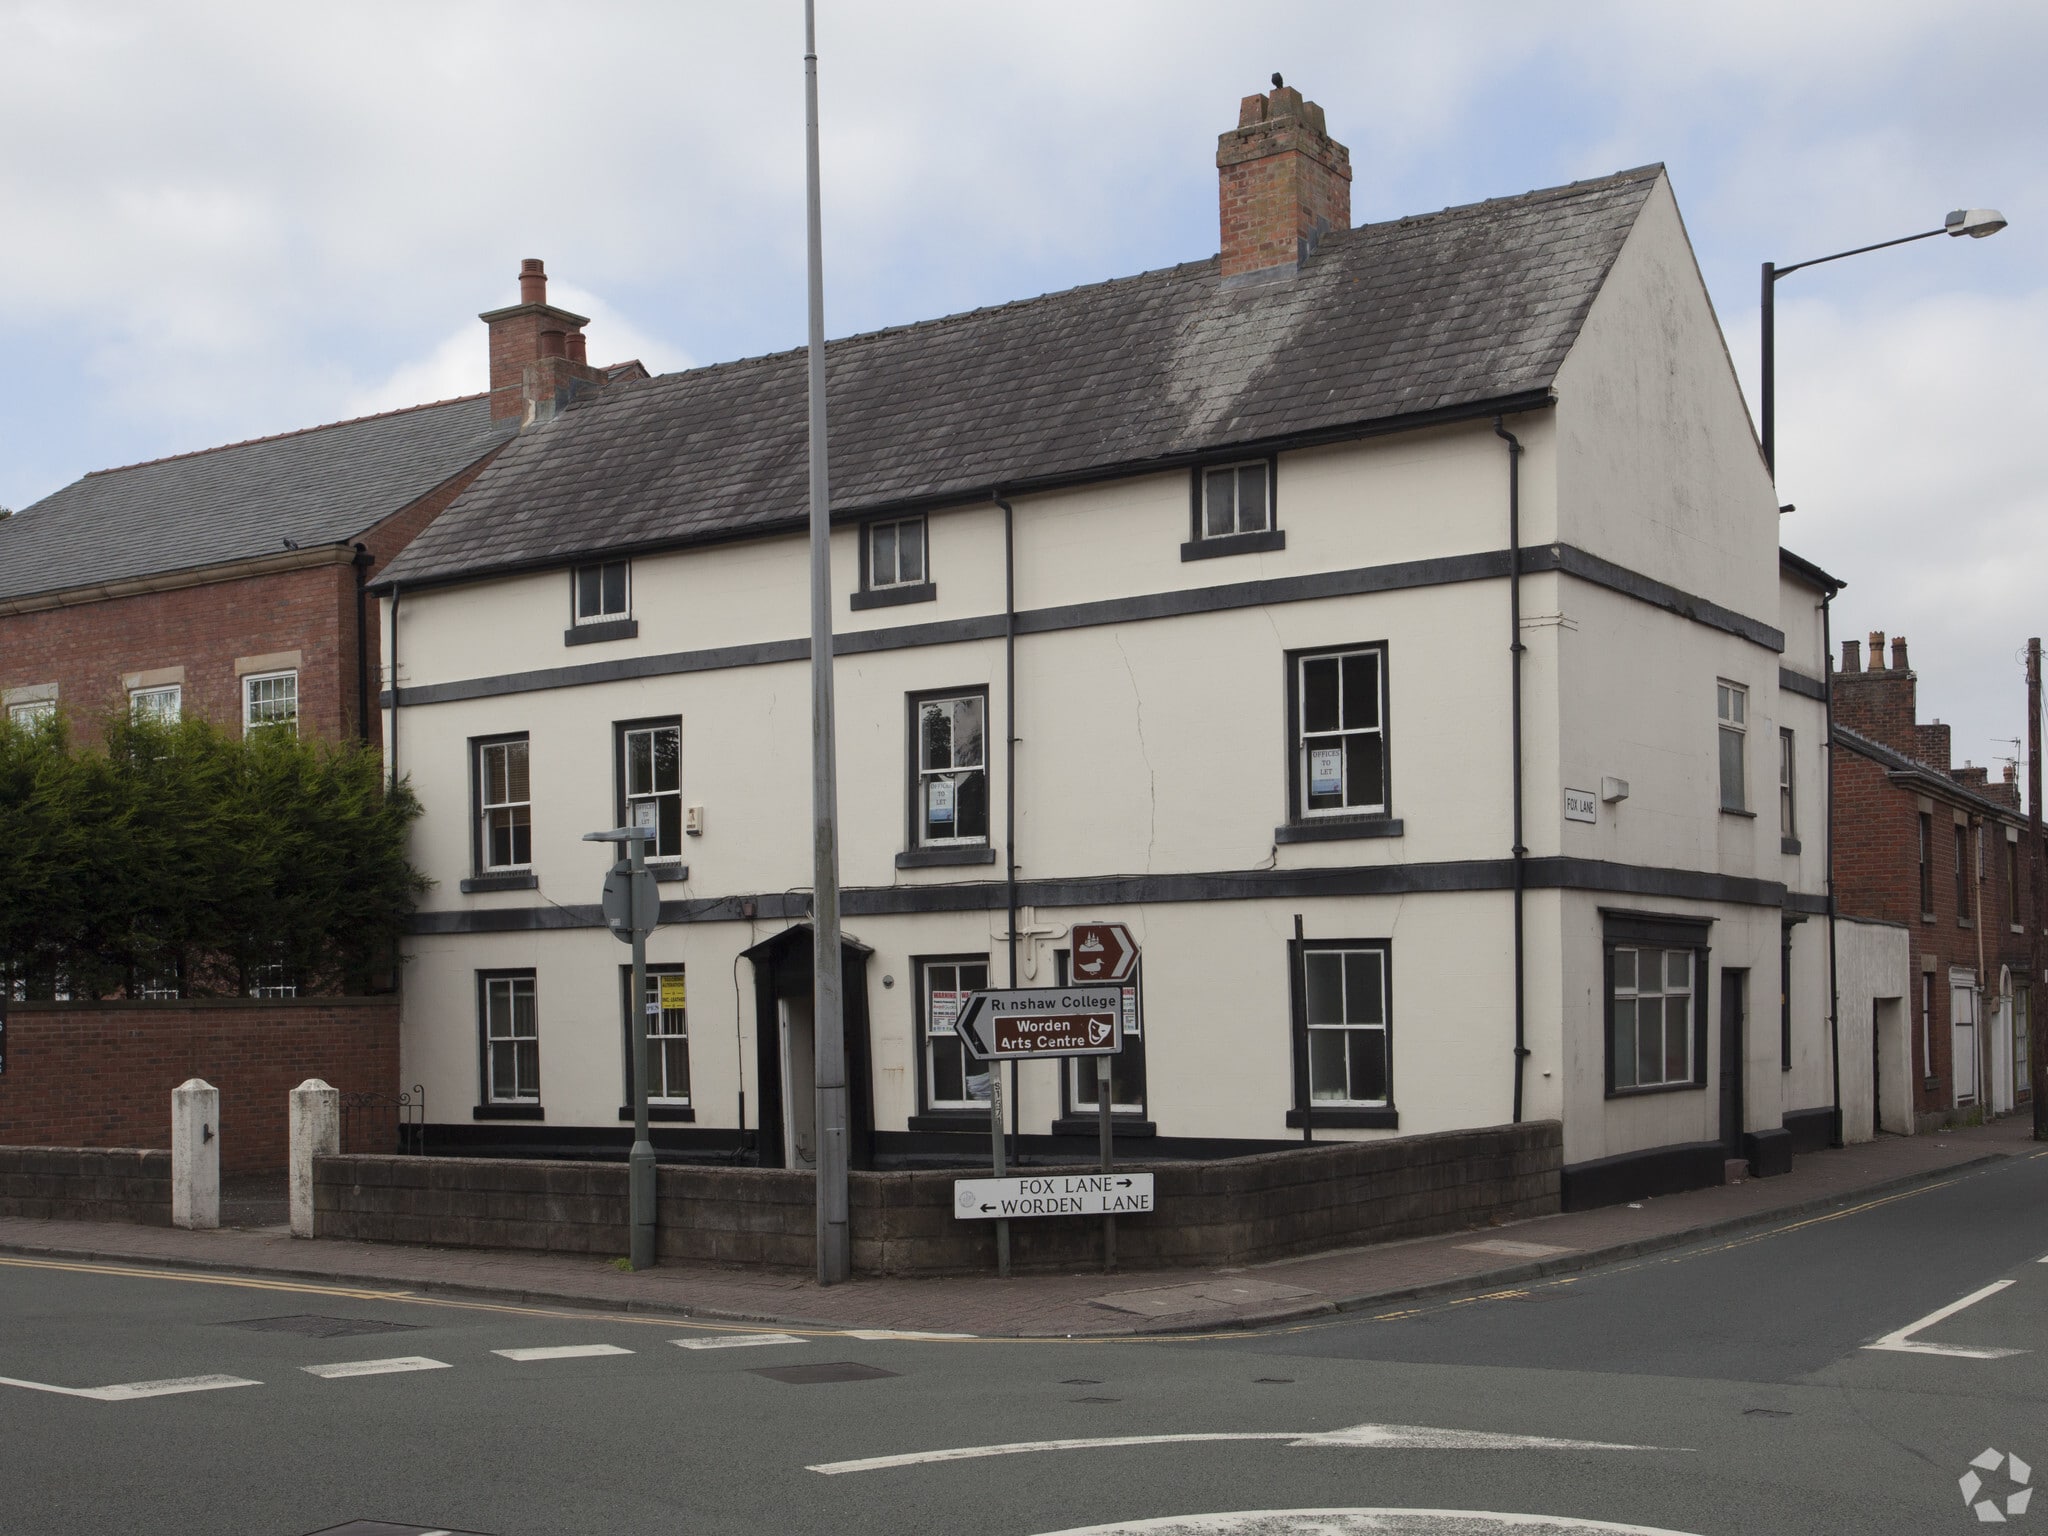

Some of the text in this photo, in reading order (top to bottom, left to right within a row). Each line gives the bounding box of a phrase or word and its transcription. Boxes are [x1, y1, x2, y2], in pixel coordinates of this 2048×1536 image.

[1567, 798, 1594, 814] FOX LANE
[1062, 996, 1116, 1009] College
[1016, 1019, 1071, 1032] Worden
[1001, 1035, 1085, 1049] Arts Centre
[1019, 1177, 1113, 1195] FOX LANE
[1001, 1194, 1149, 1215] WORDEN LANE
